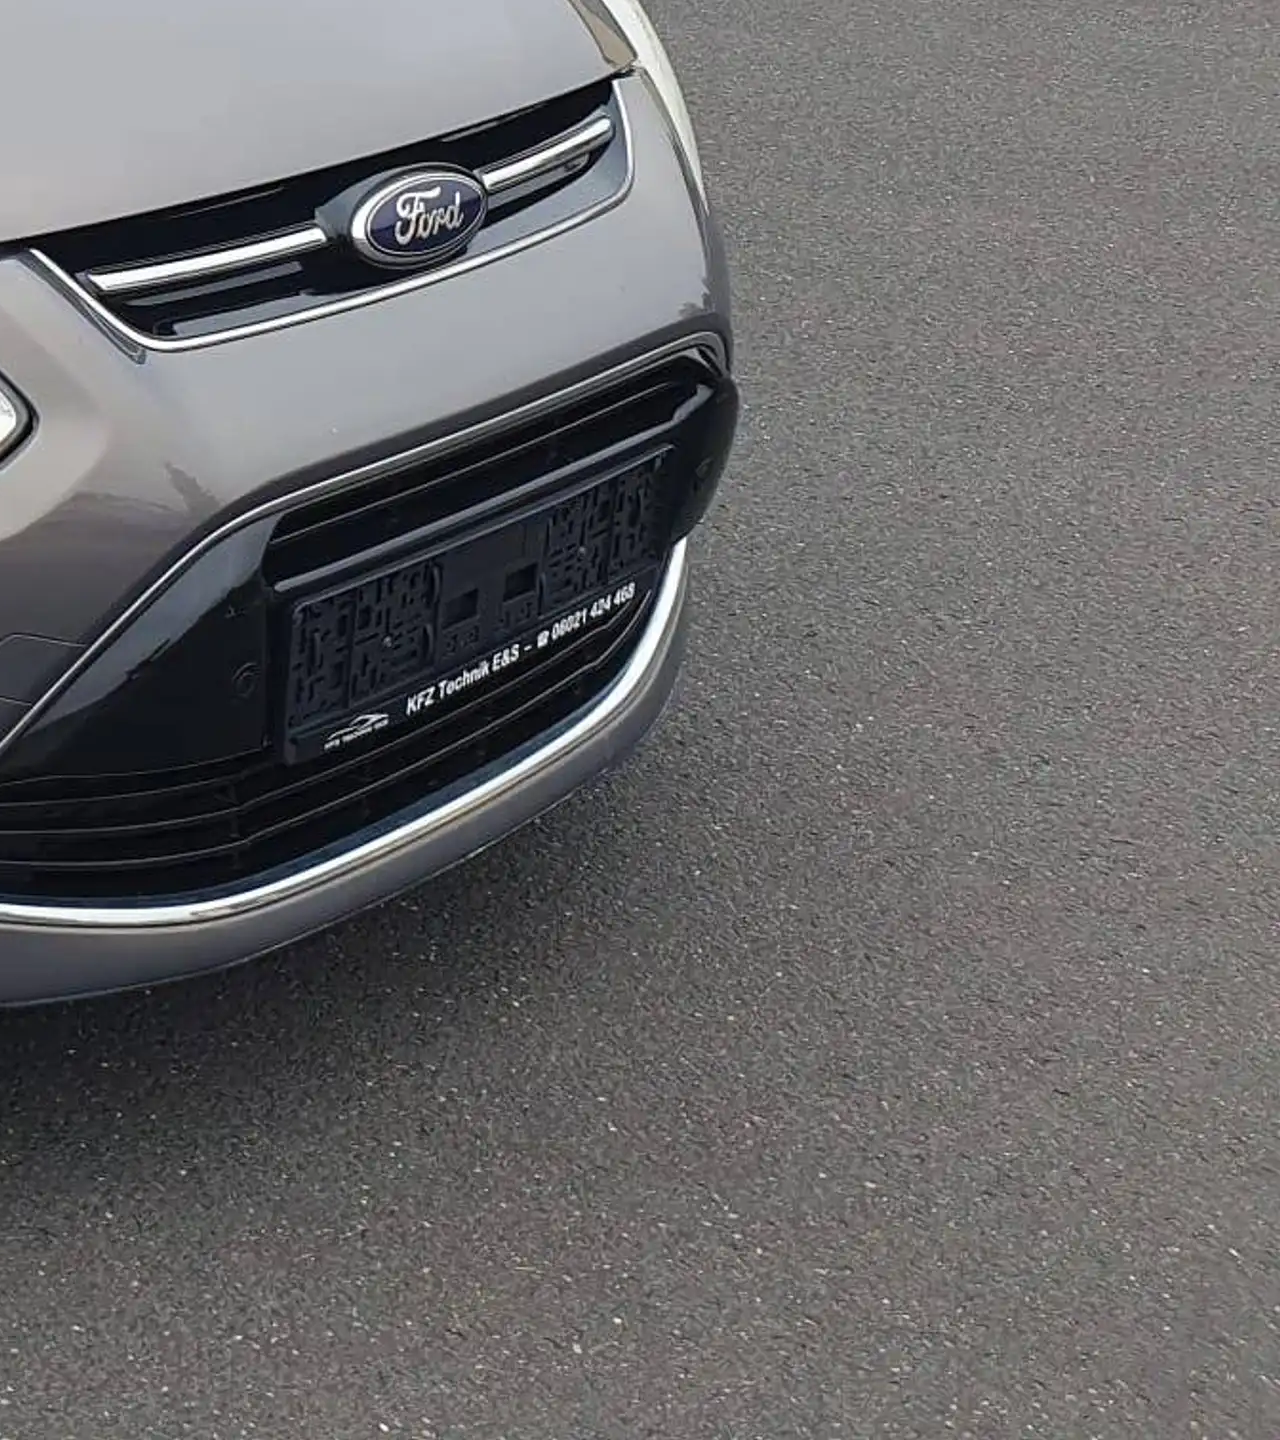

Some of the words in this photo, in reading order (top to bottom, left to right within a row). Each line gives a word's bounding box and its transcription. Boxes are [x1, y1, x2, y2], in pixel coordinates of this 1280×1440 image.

[394, 186, 465, 246] Ford
[406, 686, 436, 716] KFZ
[438, 660, 490, 699] Technik
[492, 643, 520, 672] E&S
